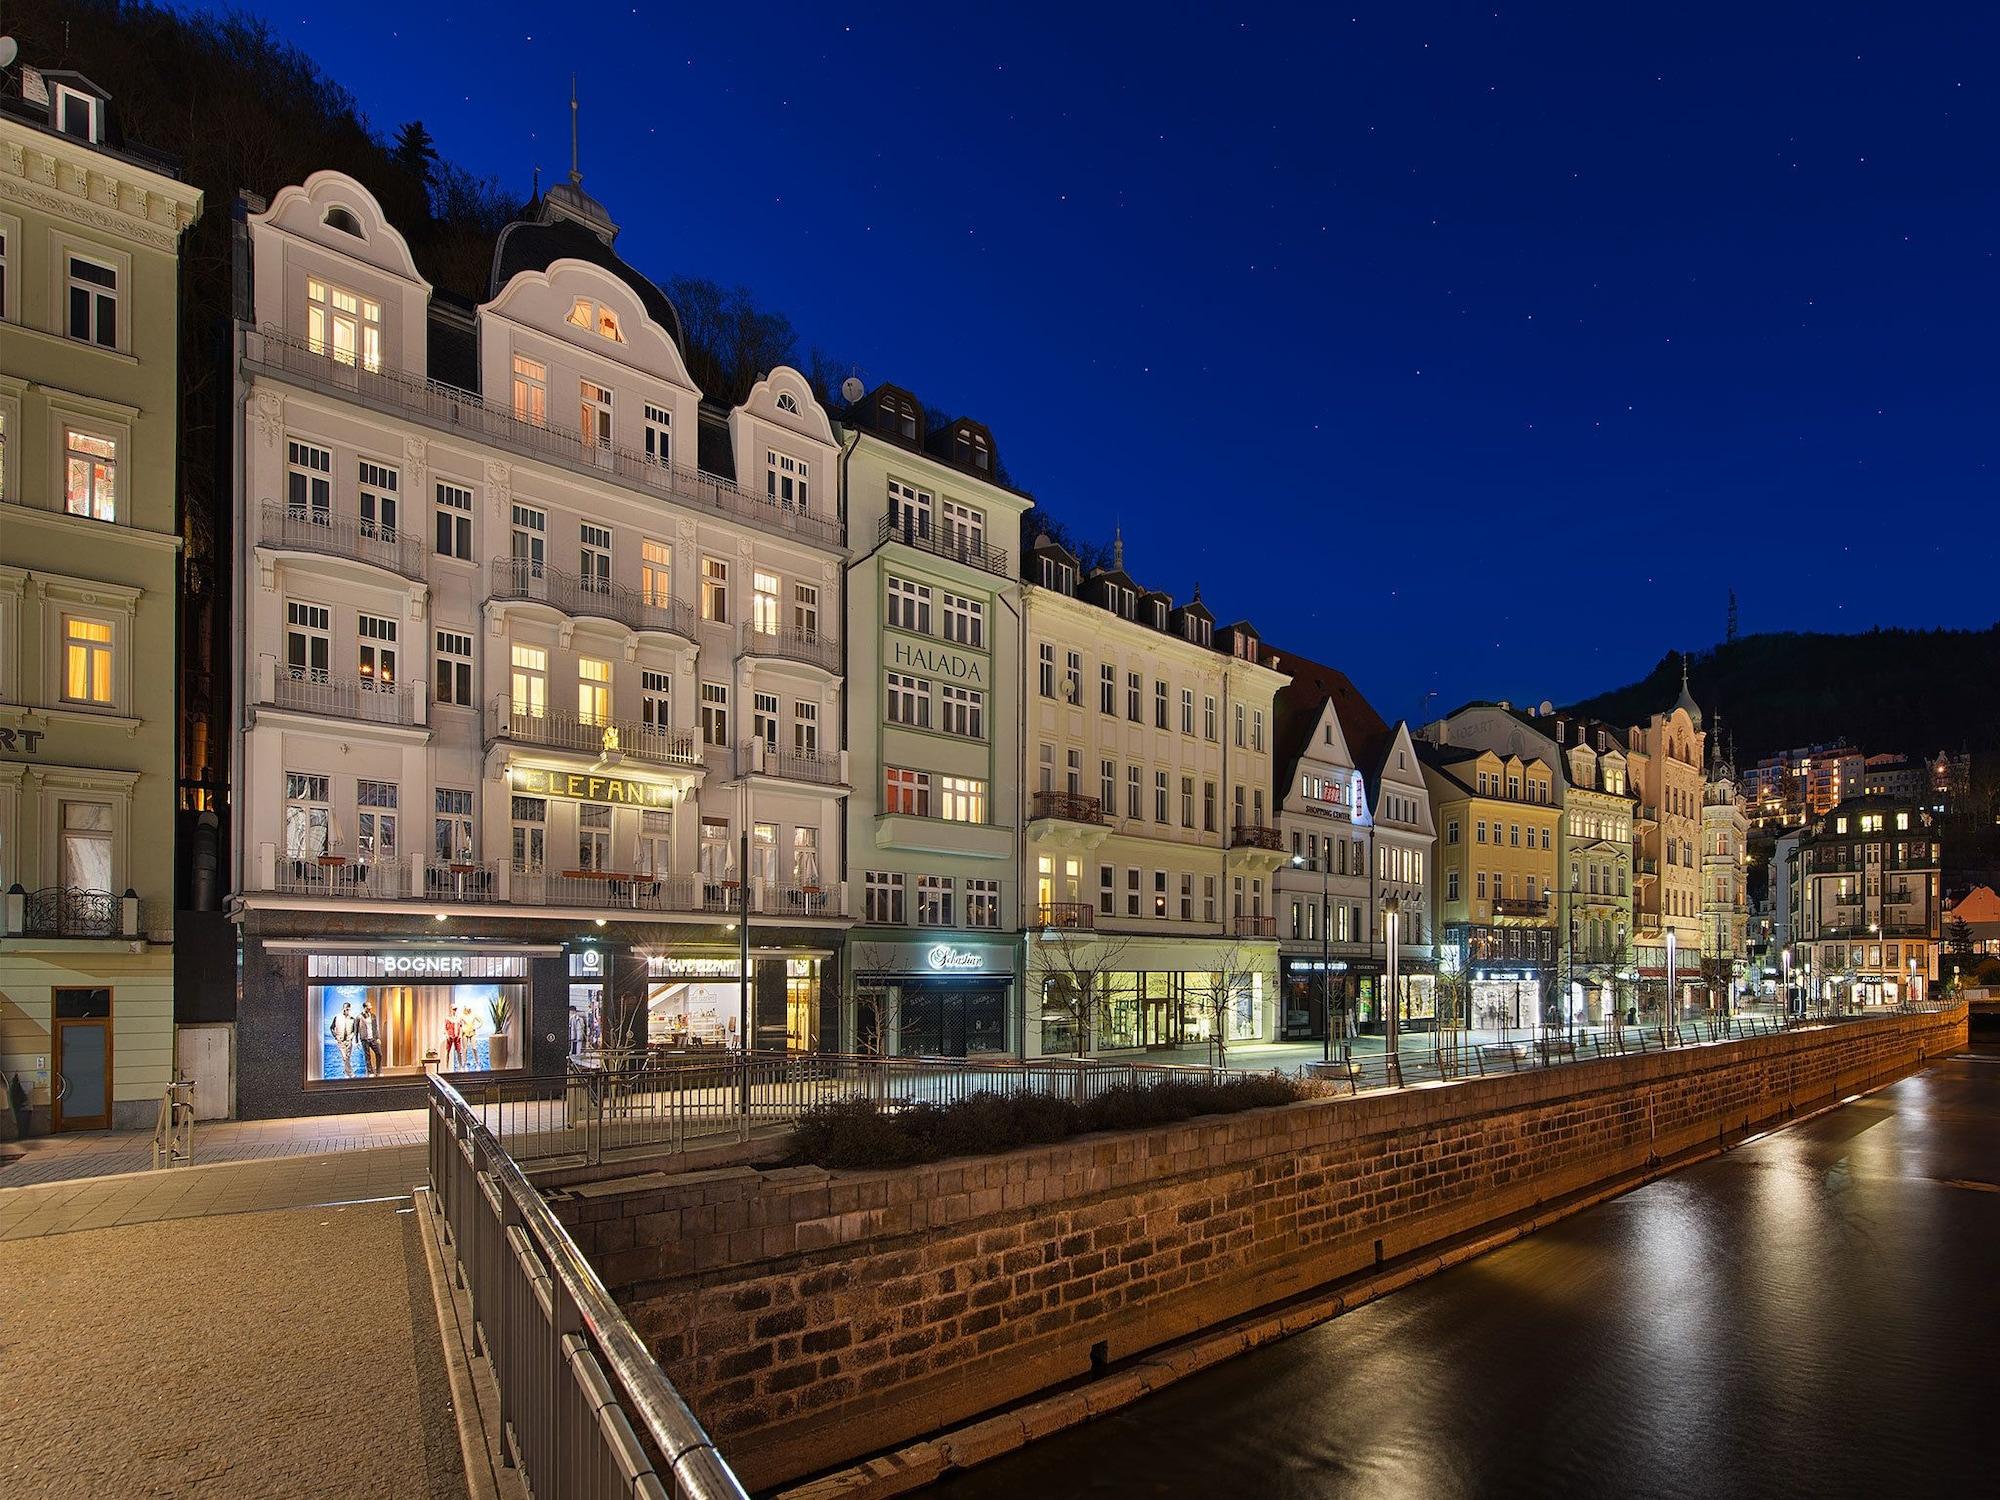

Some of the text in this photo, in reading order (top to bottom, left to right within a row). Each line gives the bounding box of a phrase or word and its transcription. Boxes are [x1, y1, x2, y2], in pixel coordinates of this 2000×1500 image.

[896, 642, 981, 682] HALADA
[525, 771, 662, 804] ELEFANT
[1305, 805, 1333, 817] SHOPPING
[384, 955, 463, 972] BOGNER
[928, 943, 984, 970] Sebastian
